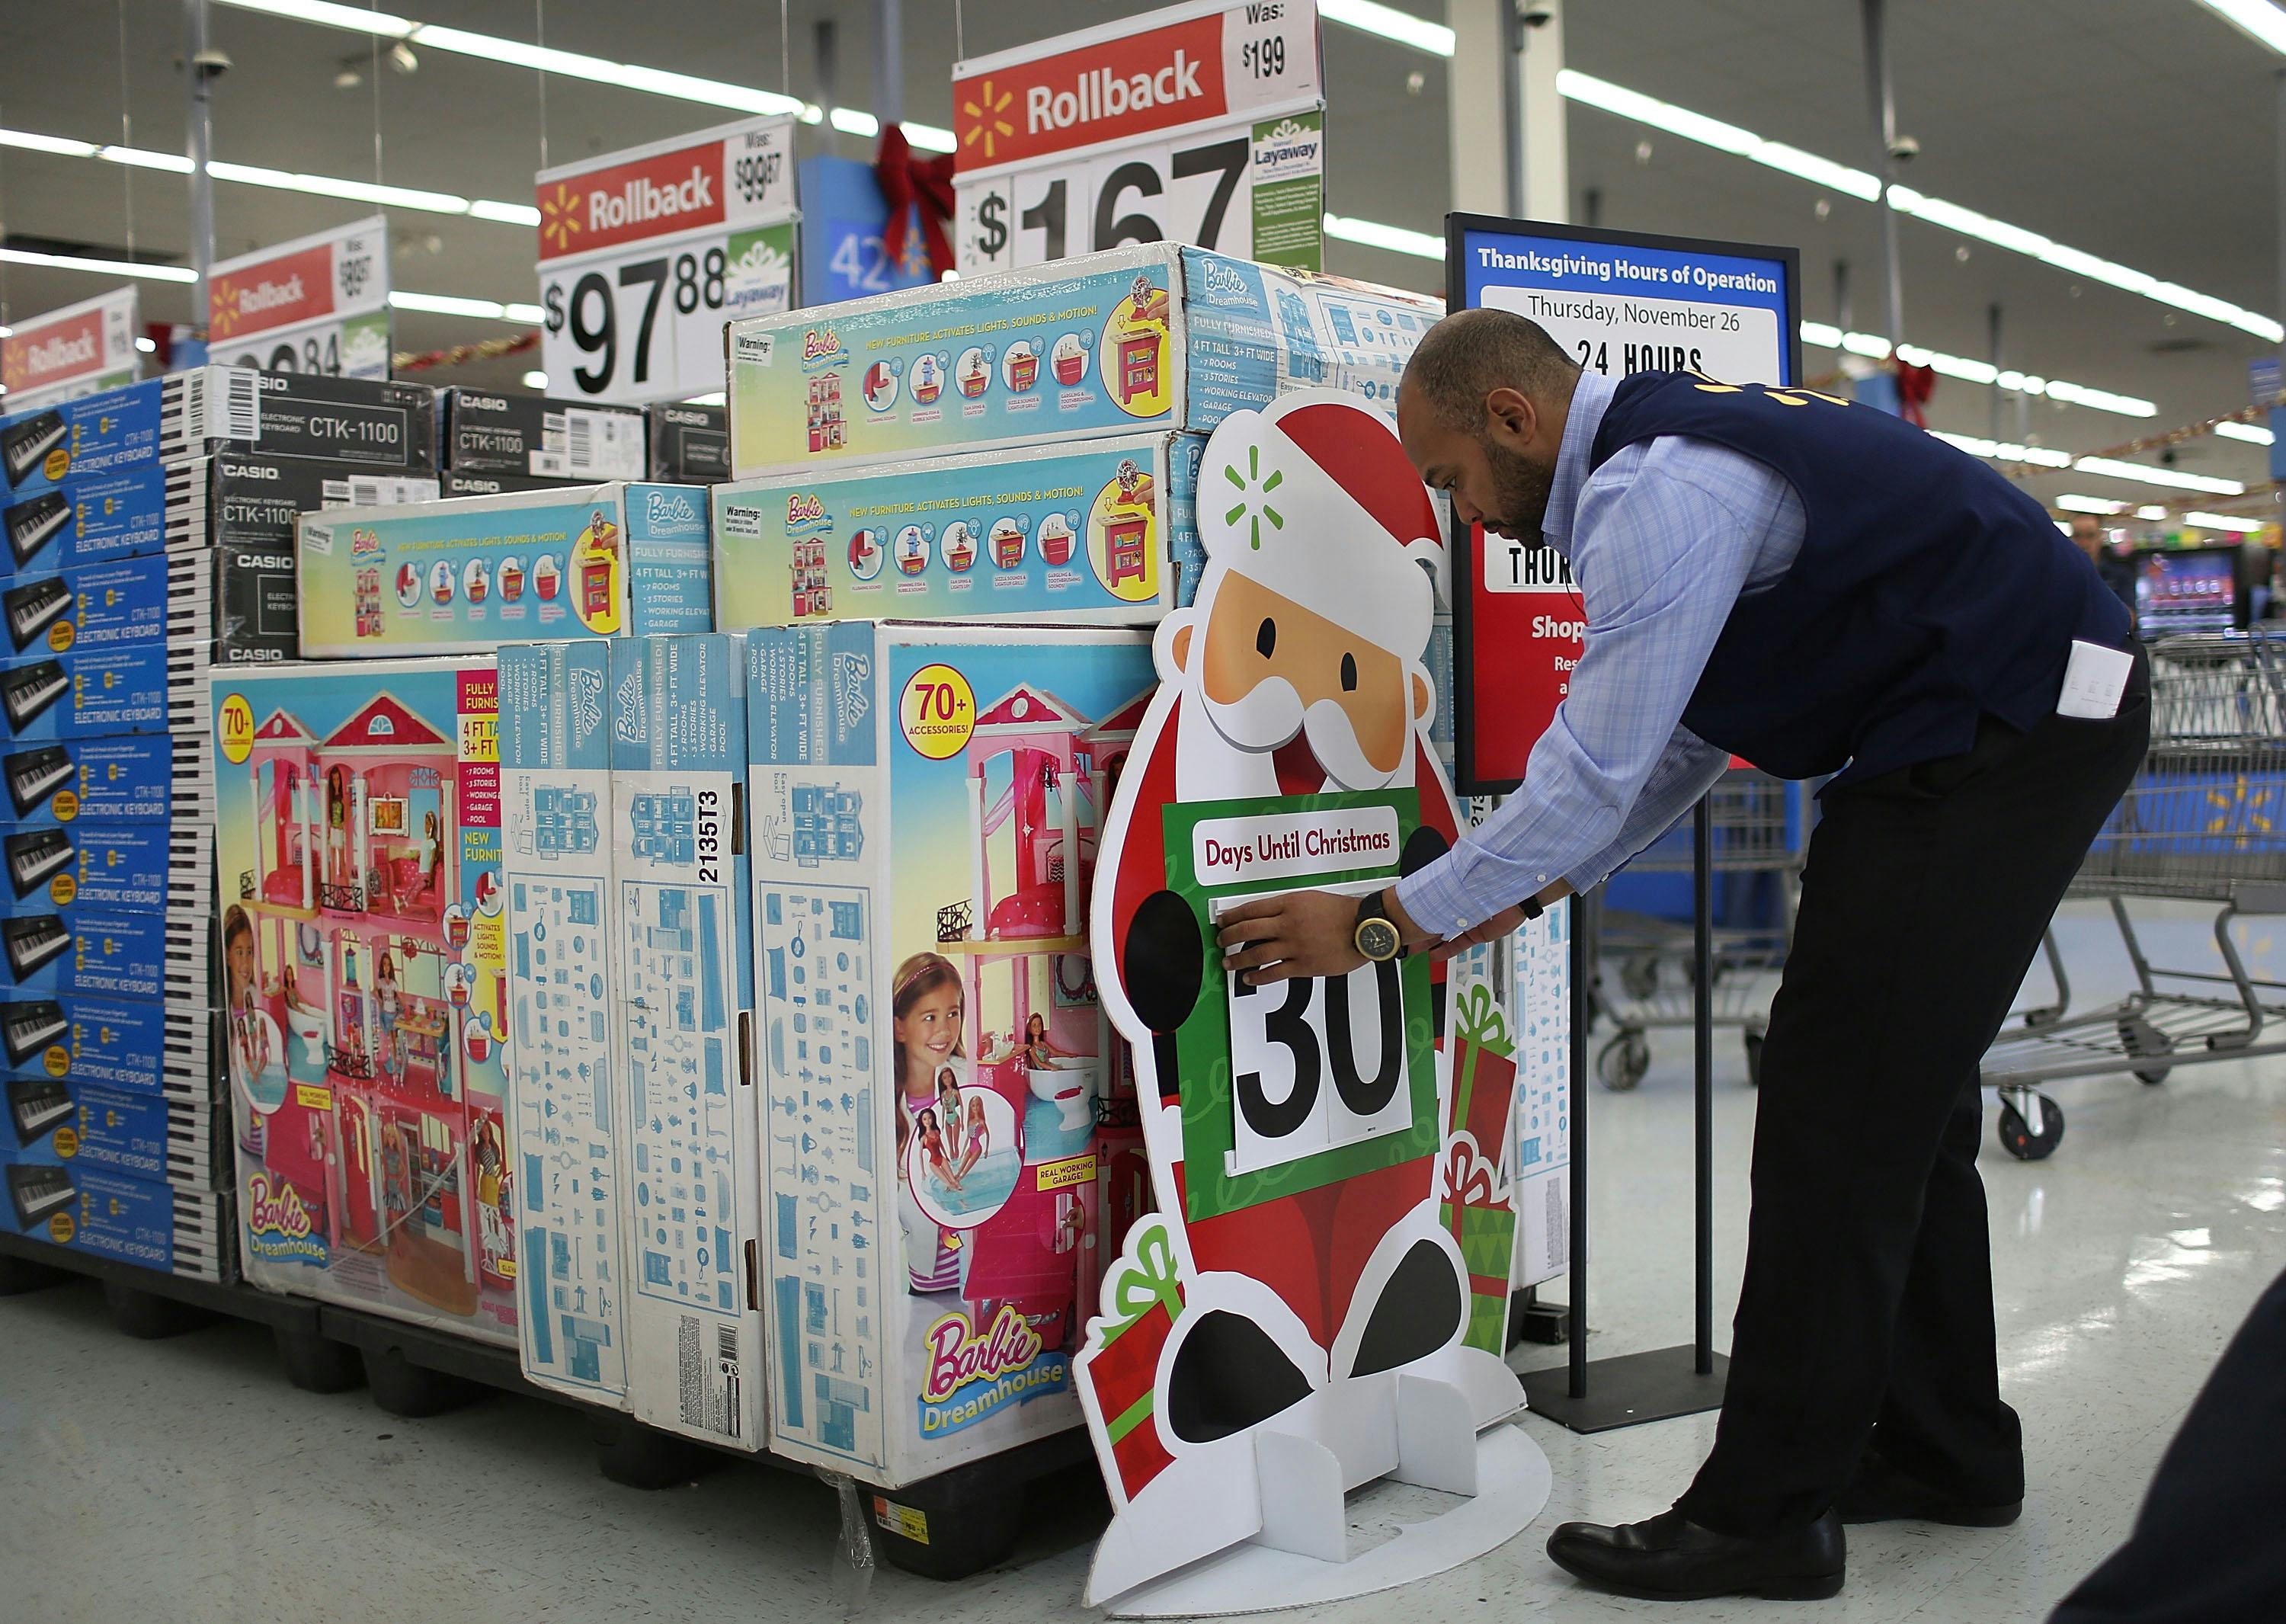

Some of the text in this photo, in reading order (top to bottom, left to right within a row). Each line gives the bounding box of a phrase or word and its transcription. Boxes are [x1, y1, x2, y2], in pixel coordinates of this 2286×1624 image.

[1246, 2, 1285, 24] Was:
[1242, 35, 1285, 79] $199
[1026, 50, 1205, 136] Rollback
[1255, 143, 1317, 165] Layaway
[589, 165, 714, 232] Rollback
[830, 232, 891, 290] 42
[1478, 248, 1776, 293] Thanksgiving Hours of Operation
[1202, 259, 1245, 293] Barbie
[239, 273, 304, 316] Rollback
[725, 281, 786, 307] Layaway
[1209, 295, 1257, 306] Dreamhouse
[1528, 295, 1740, 332] Thursday, November 26
[866, 306, 1097, 351] NEW FURNITURE ACTIVATES LIGHTS, SOUNDS & MOTION!
[1194, 316, 1274, 339] FULLY FURNISHED!
[28, 328, 97, 375] Rollback
[738, 337, 771, 353] Warning:
[805, 331, 840, 358] Barbie
[1194, 341, 1275, 362] 4 FT TALL 3+ FT WIDE
[803, 353, 848, 371] Dreamhouse
[1209, 359, 1236, 370] ROOMS
[1577, 339, 1702, 377] 24 HOURS
[1210, 373, 1238, 384] STORIES
[460, 395, 508, 412] CASIO
[1203, 402, 1232, 412] GARAGE
[1204, 387, 1273, 404] WORKING ELEVATOR
[261, 413, 305, 424] ELECTRONIC
[261, 424, 300, 433] KEYBOARD
[664, 409, 709, 426] CASIO
[309, 417, 398, 444] CTK-1100
[459, 433, 523, 454] CTK-1100
[70, 453, 113, 472] ELECTRONIC
[114, 447, 152, 463] KEYBOARD
[223, 465, 280, 479] CASIO
[451, 479, 499, 493] CASIO
[647, 492, 694, 521] Barbie
[727, 506, 760, 520] Warning:
[789, 495, 823, 522] Barbie
[850, 487, 1084, 517] NEW FURNITURE ACTIVATES LIGHTS, SOUNDS & MOTION!
[223, 505, 296, 524] CTK-1100
[787, 518, 832, 535] Dreamhouse
[651, 523, 706, 535] Dreamhouse
[76, 530, 158, 553] ELECTRONIC KEYBOARD
[352, 530, 378, 554] Barbie
[635, 548, 664, 557] FULLY
[237, 555, 293, 569] CASIO
[1532, 615, 1584, 643] Shop
[229, 649, 283, 661] CASIO
[799, 643, 806, 656] FT
[466, 684, 494, 695] FULLY
[580, 668, 603, 735] Barbie
[636, 660, 647, 739] Dreamhouse
[815, 633, 823, 761] FULLY FURNISHED!
[832, 658, 845, 742] Dreamhouse
[844, 653, 870, 728] Barbie
[571, 673, 580, 748] Dreamhouse
[616, 674, 636, 742] Barbie
[915, 683, 966, 721] 70+
[799, 714, 807, 726] FT
[908, 724, 968, 735] ACCESSORIES!
[465, 832, 489, 844] NEW
[699, 790, 718, 882] 2135T3
[1205, 828, 1391, 872] Days Until Christmas
[1233, 945, 1404, 1138] 30
[1041, 1161, 1093, 1179] REAL WORKING
[1052, 1172, 1083, 1184] GARAGE!
[251, 1177, 309, 1234] Barbie
[251, 1236, 326, 1260] Dreamhouse
[927, 1311, 1037, 1398] Barbie
[924, 1363, 1062, 1431] Dreamhouse
